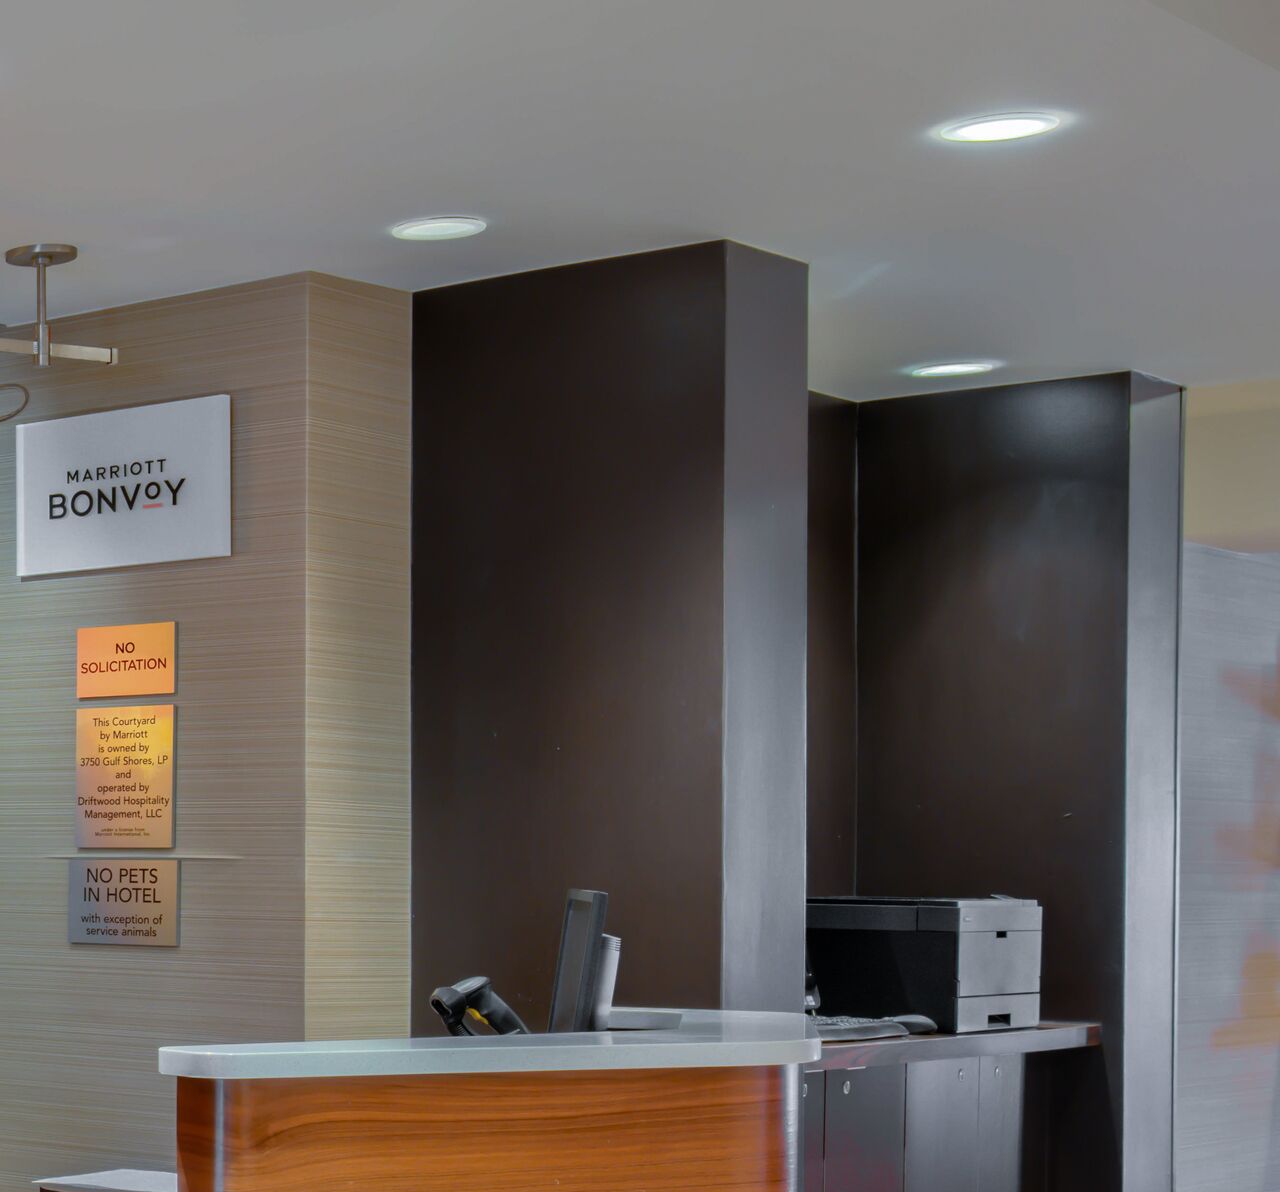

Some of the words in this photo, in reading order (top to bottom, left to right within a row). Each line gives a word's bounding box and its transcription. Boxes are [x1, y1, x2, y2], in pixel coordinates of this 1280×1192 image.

[67, 459, 166, 484] MARRIOTT
[115, 642, 135, 654] NO
[81, 658, 167, 674] SOLICITATION
[93, 718, 110, 727] This
[112, 715, 156, 728] Courtyard
[100, 731, 110, 742] by
[113, 730, 148, 740] Marriott
[98, 745, 105, 753] is
[107, 743, 136, 753] owned
[139, 743, 150, 754] by
[80, 757, 100, 767] 3750
[103, 756, 120, 766] Gulf
[123, 755, 154, 766] Shores,
[157, 755, 168, 765] LP
[115, 770, 132, 779] and
[97, 783, 136, 793] operated
[139, 782, 150, 793] by
[78, 796, 121, 806] Driftwood
[123, 796, 170, 807] Hospitality
[84, 810, 143, 821] Management,
[145, 809, 162, 818] LLC
[86, 868, 113, 883] NO
[119, 868, 158, 884] PETS
[83, 887, 100, 902] IN
[106, 887, 162, 903] HOTEL
[81, 914, 100, 923] with
[104, 914, 149, 927] exception
[152, 914, 163, 925] of
[86, 927, 119, 936] service
[121, 927, 157, 937] animals
